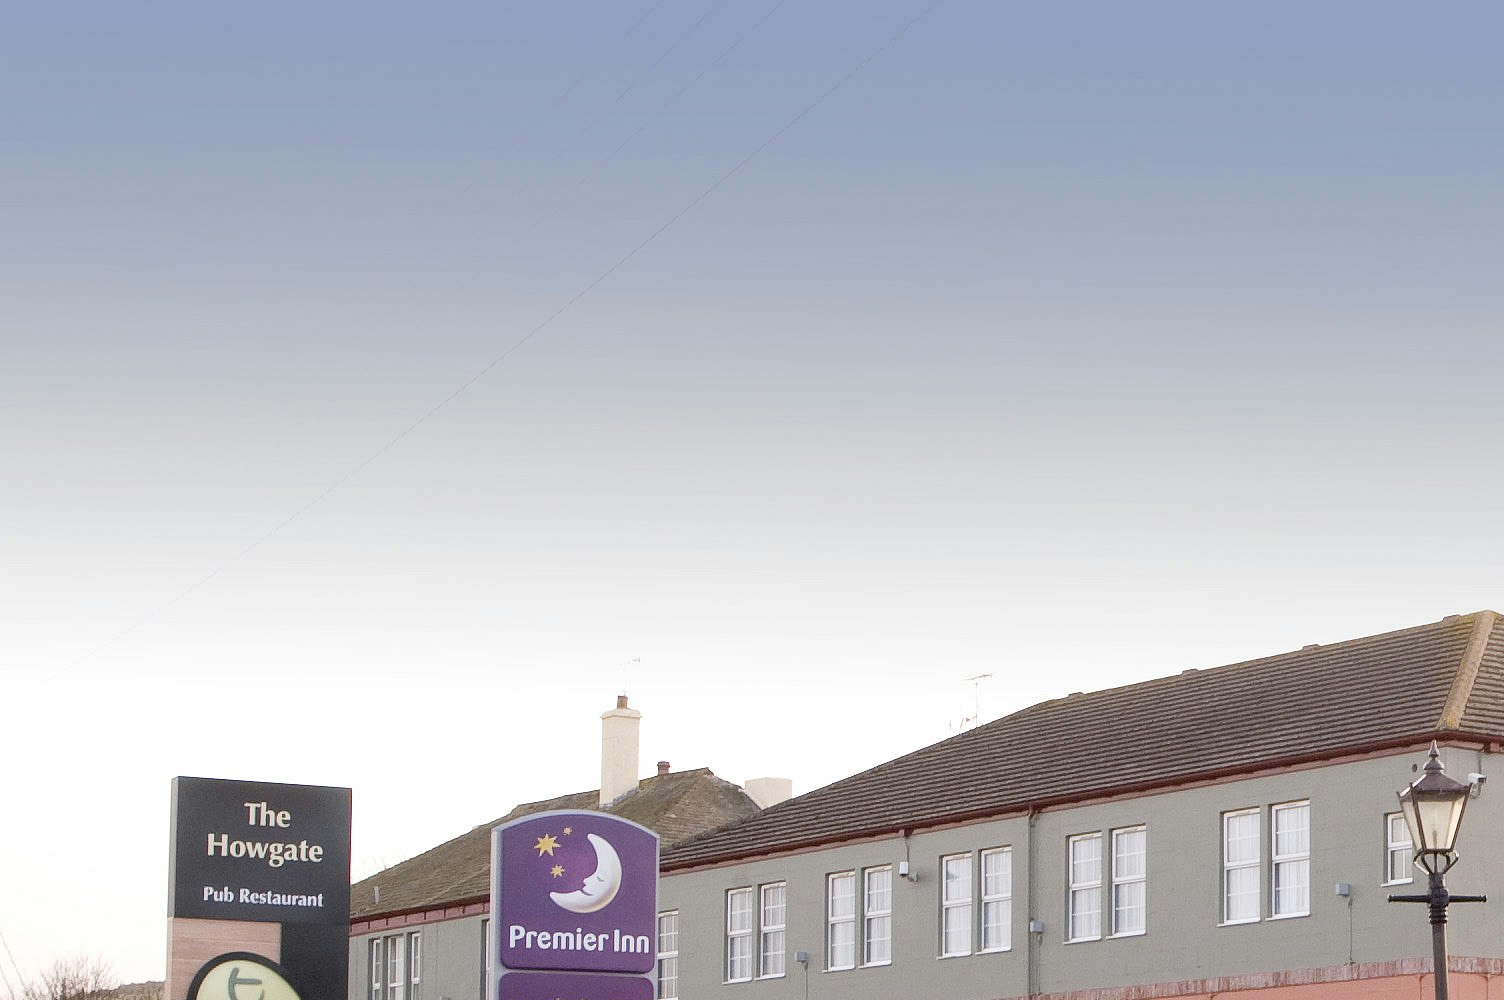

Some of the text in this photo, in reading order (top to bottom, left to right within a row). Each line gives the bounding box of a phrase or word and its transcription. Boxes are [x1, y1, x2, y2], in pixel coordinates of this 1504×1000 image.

[244, 802, 291, 827] The
[207, 833, 323, 868] Howgate
[203, 886, 323, 907] Pub Restaurant
[509, 925, 649, 953] Premier Inn
